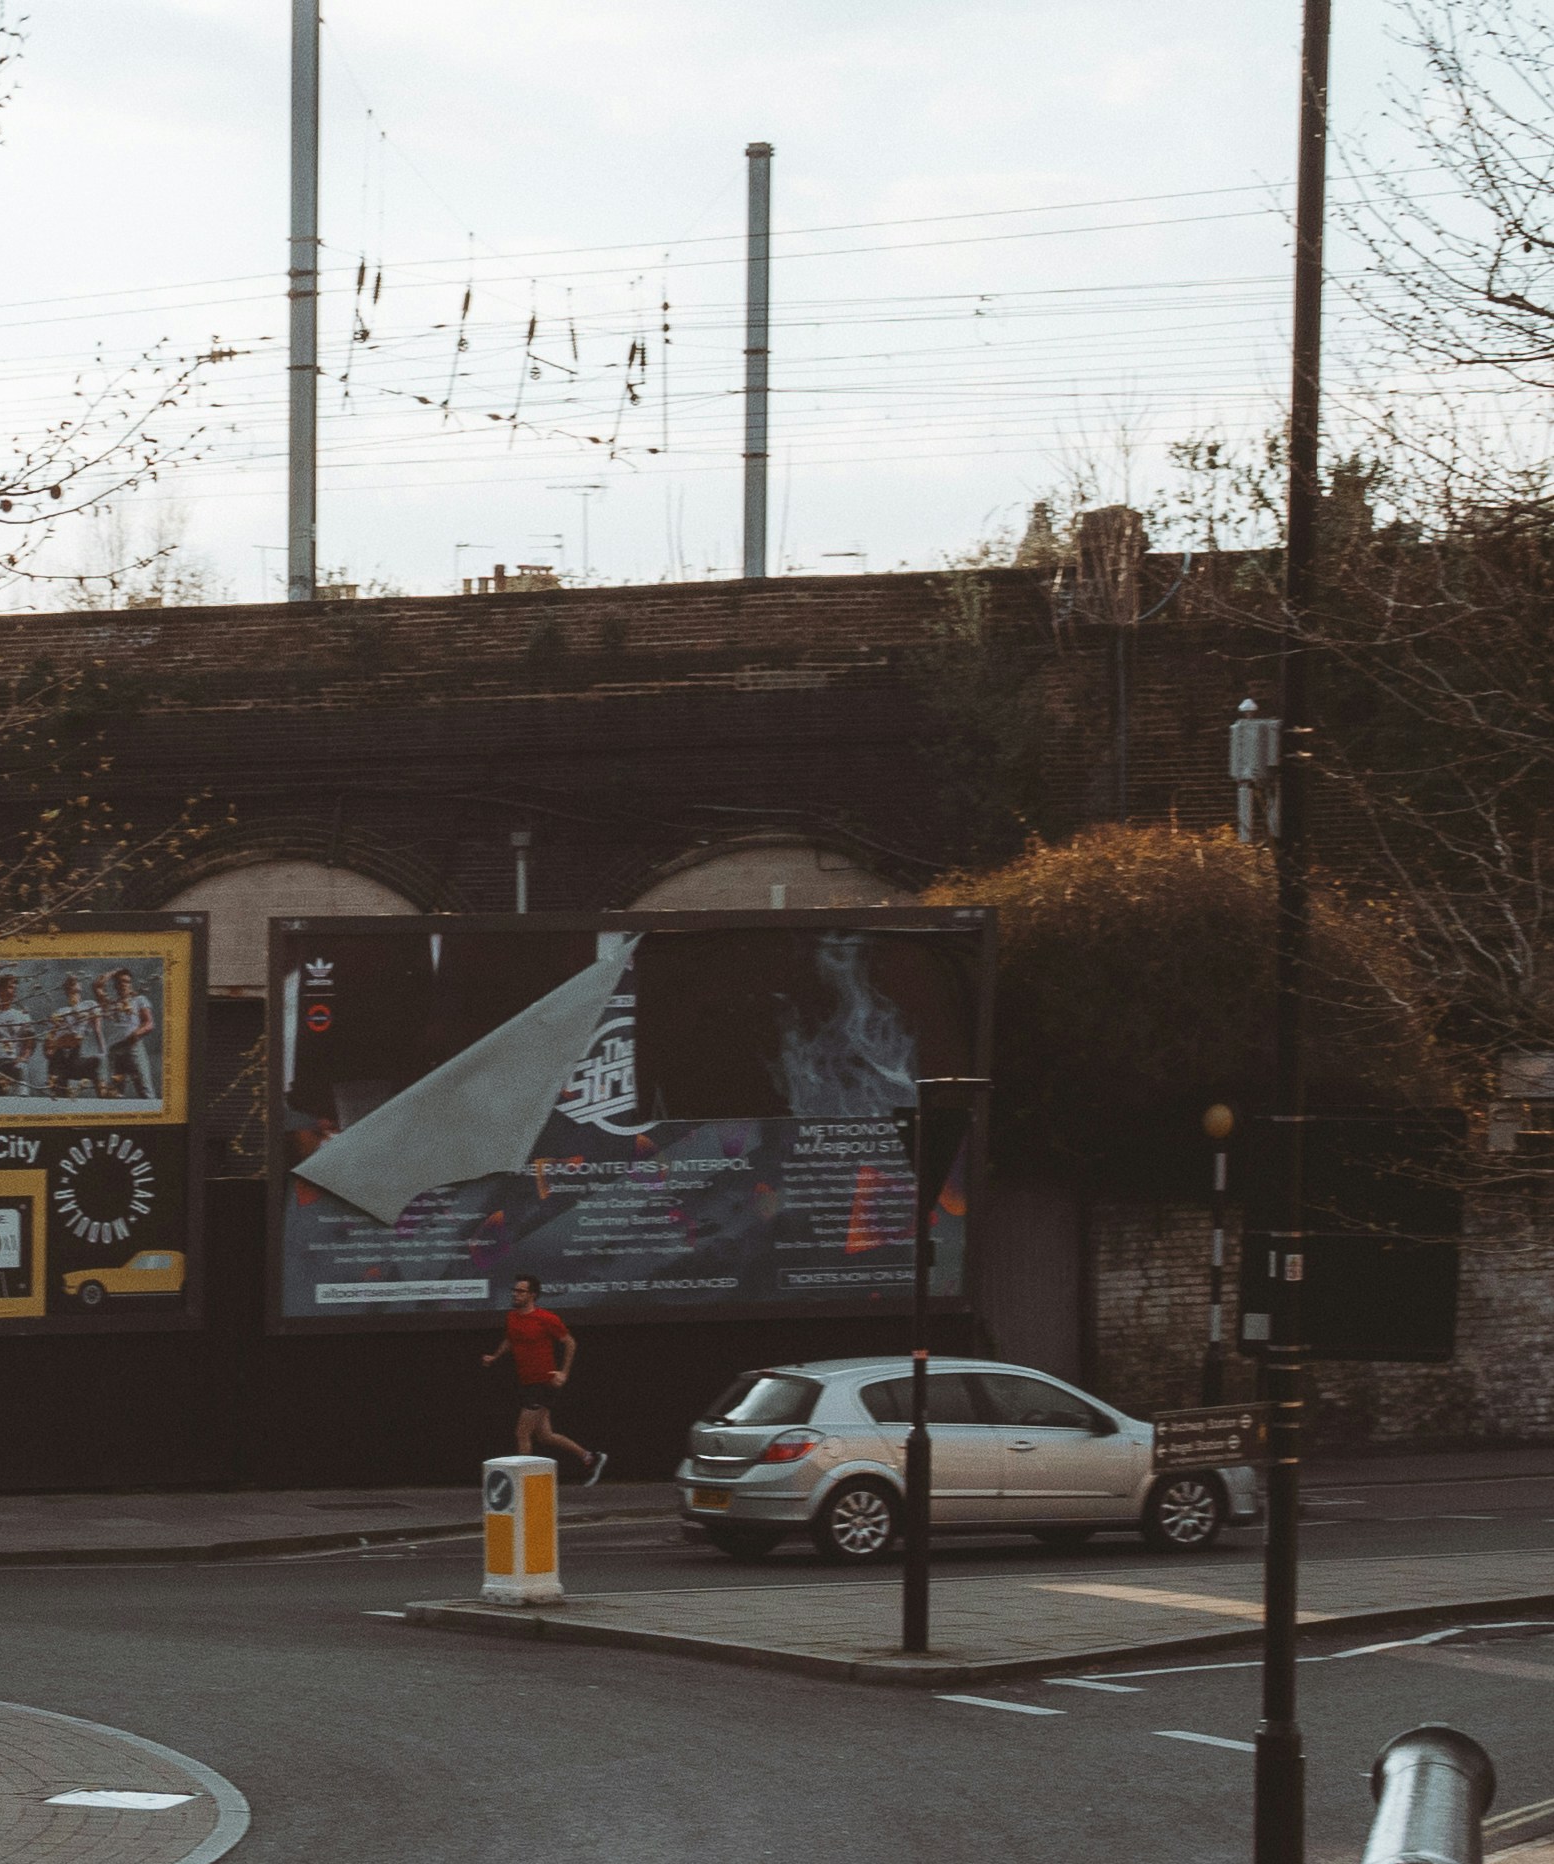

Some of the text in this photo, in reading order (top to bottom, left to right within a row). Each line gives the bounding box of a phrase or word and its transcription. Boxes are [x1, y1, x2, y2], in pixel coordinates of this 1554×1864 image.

[793, 1141, 876, 1155] MARIBOU
[541, 1160, 659, 1175] RACONTEURS
[672, 1157, 754, 1172] INTERPOL
[568, 1281, 609, 1293] MORE
[611, 1280, 629, 1292] TO
[631, 1280, 649, 1291] BE
[650, 1277, 739, 1290] ANNOUNCED
